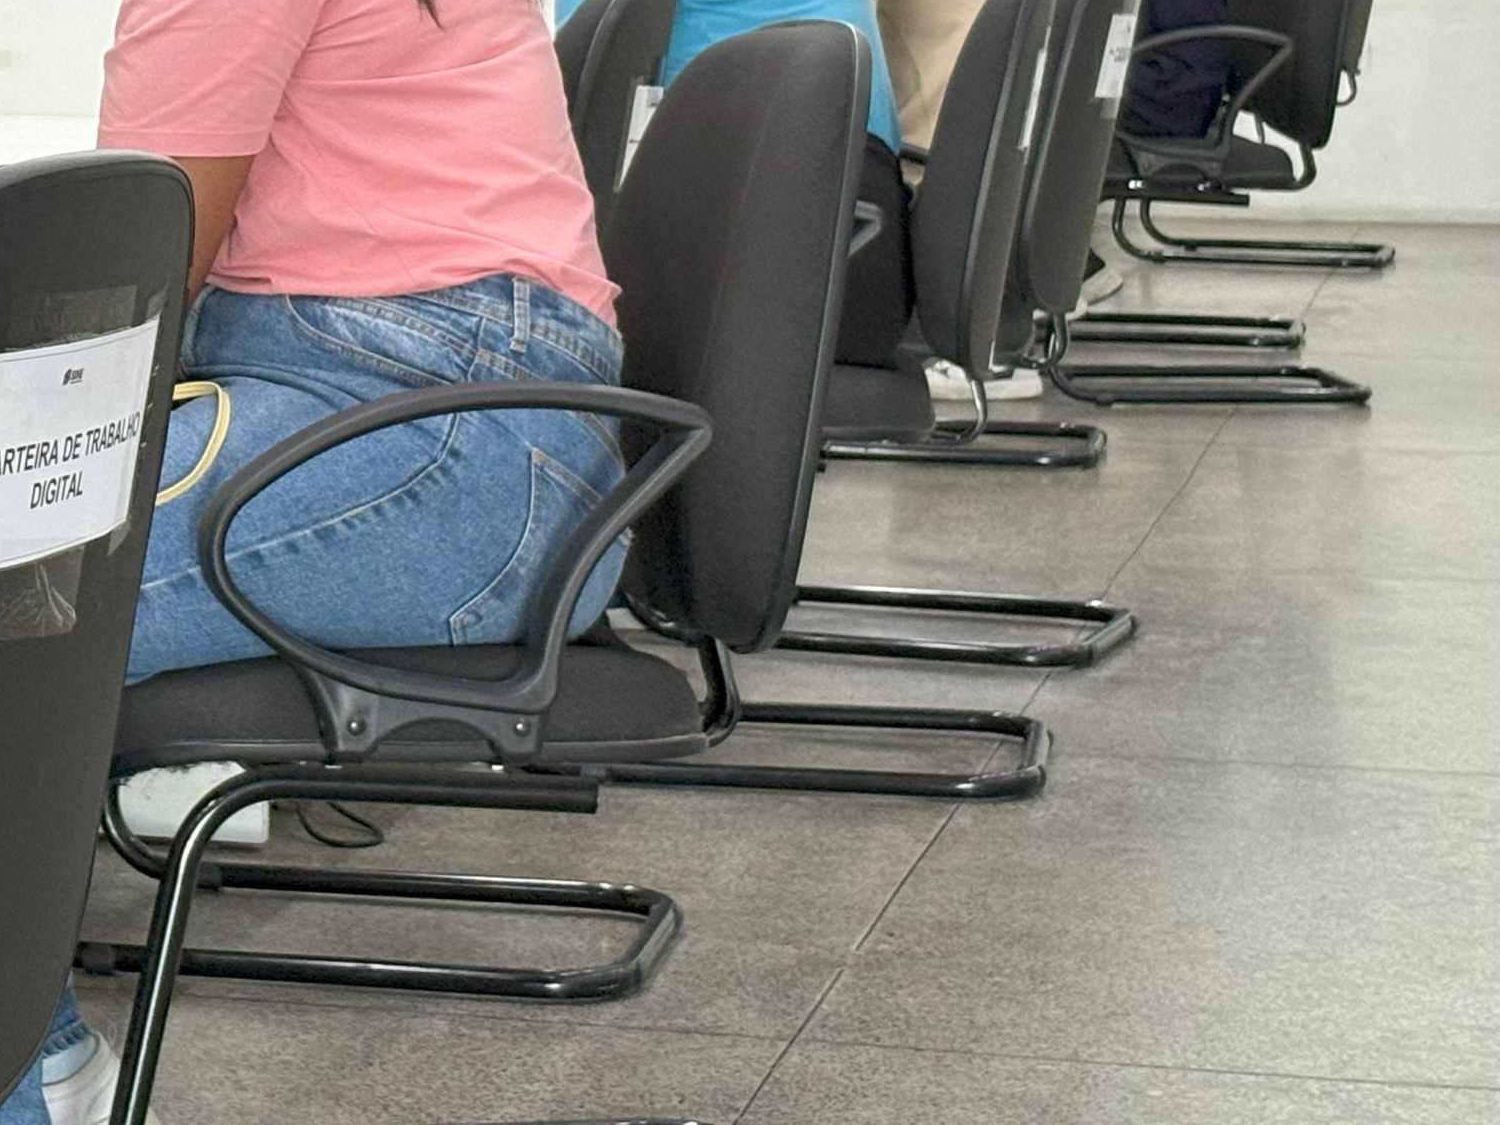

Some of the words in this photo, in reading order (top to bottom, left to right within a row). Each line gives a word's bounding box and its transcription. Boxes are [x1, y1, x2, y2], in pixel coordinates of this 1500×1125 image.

[62, 433, 83, 462] DE
[85, 411, 141, 456] TRABALHO
[30, 471, 83, 509] DIGITAL
